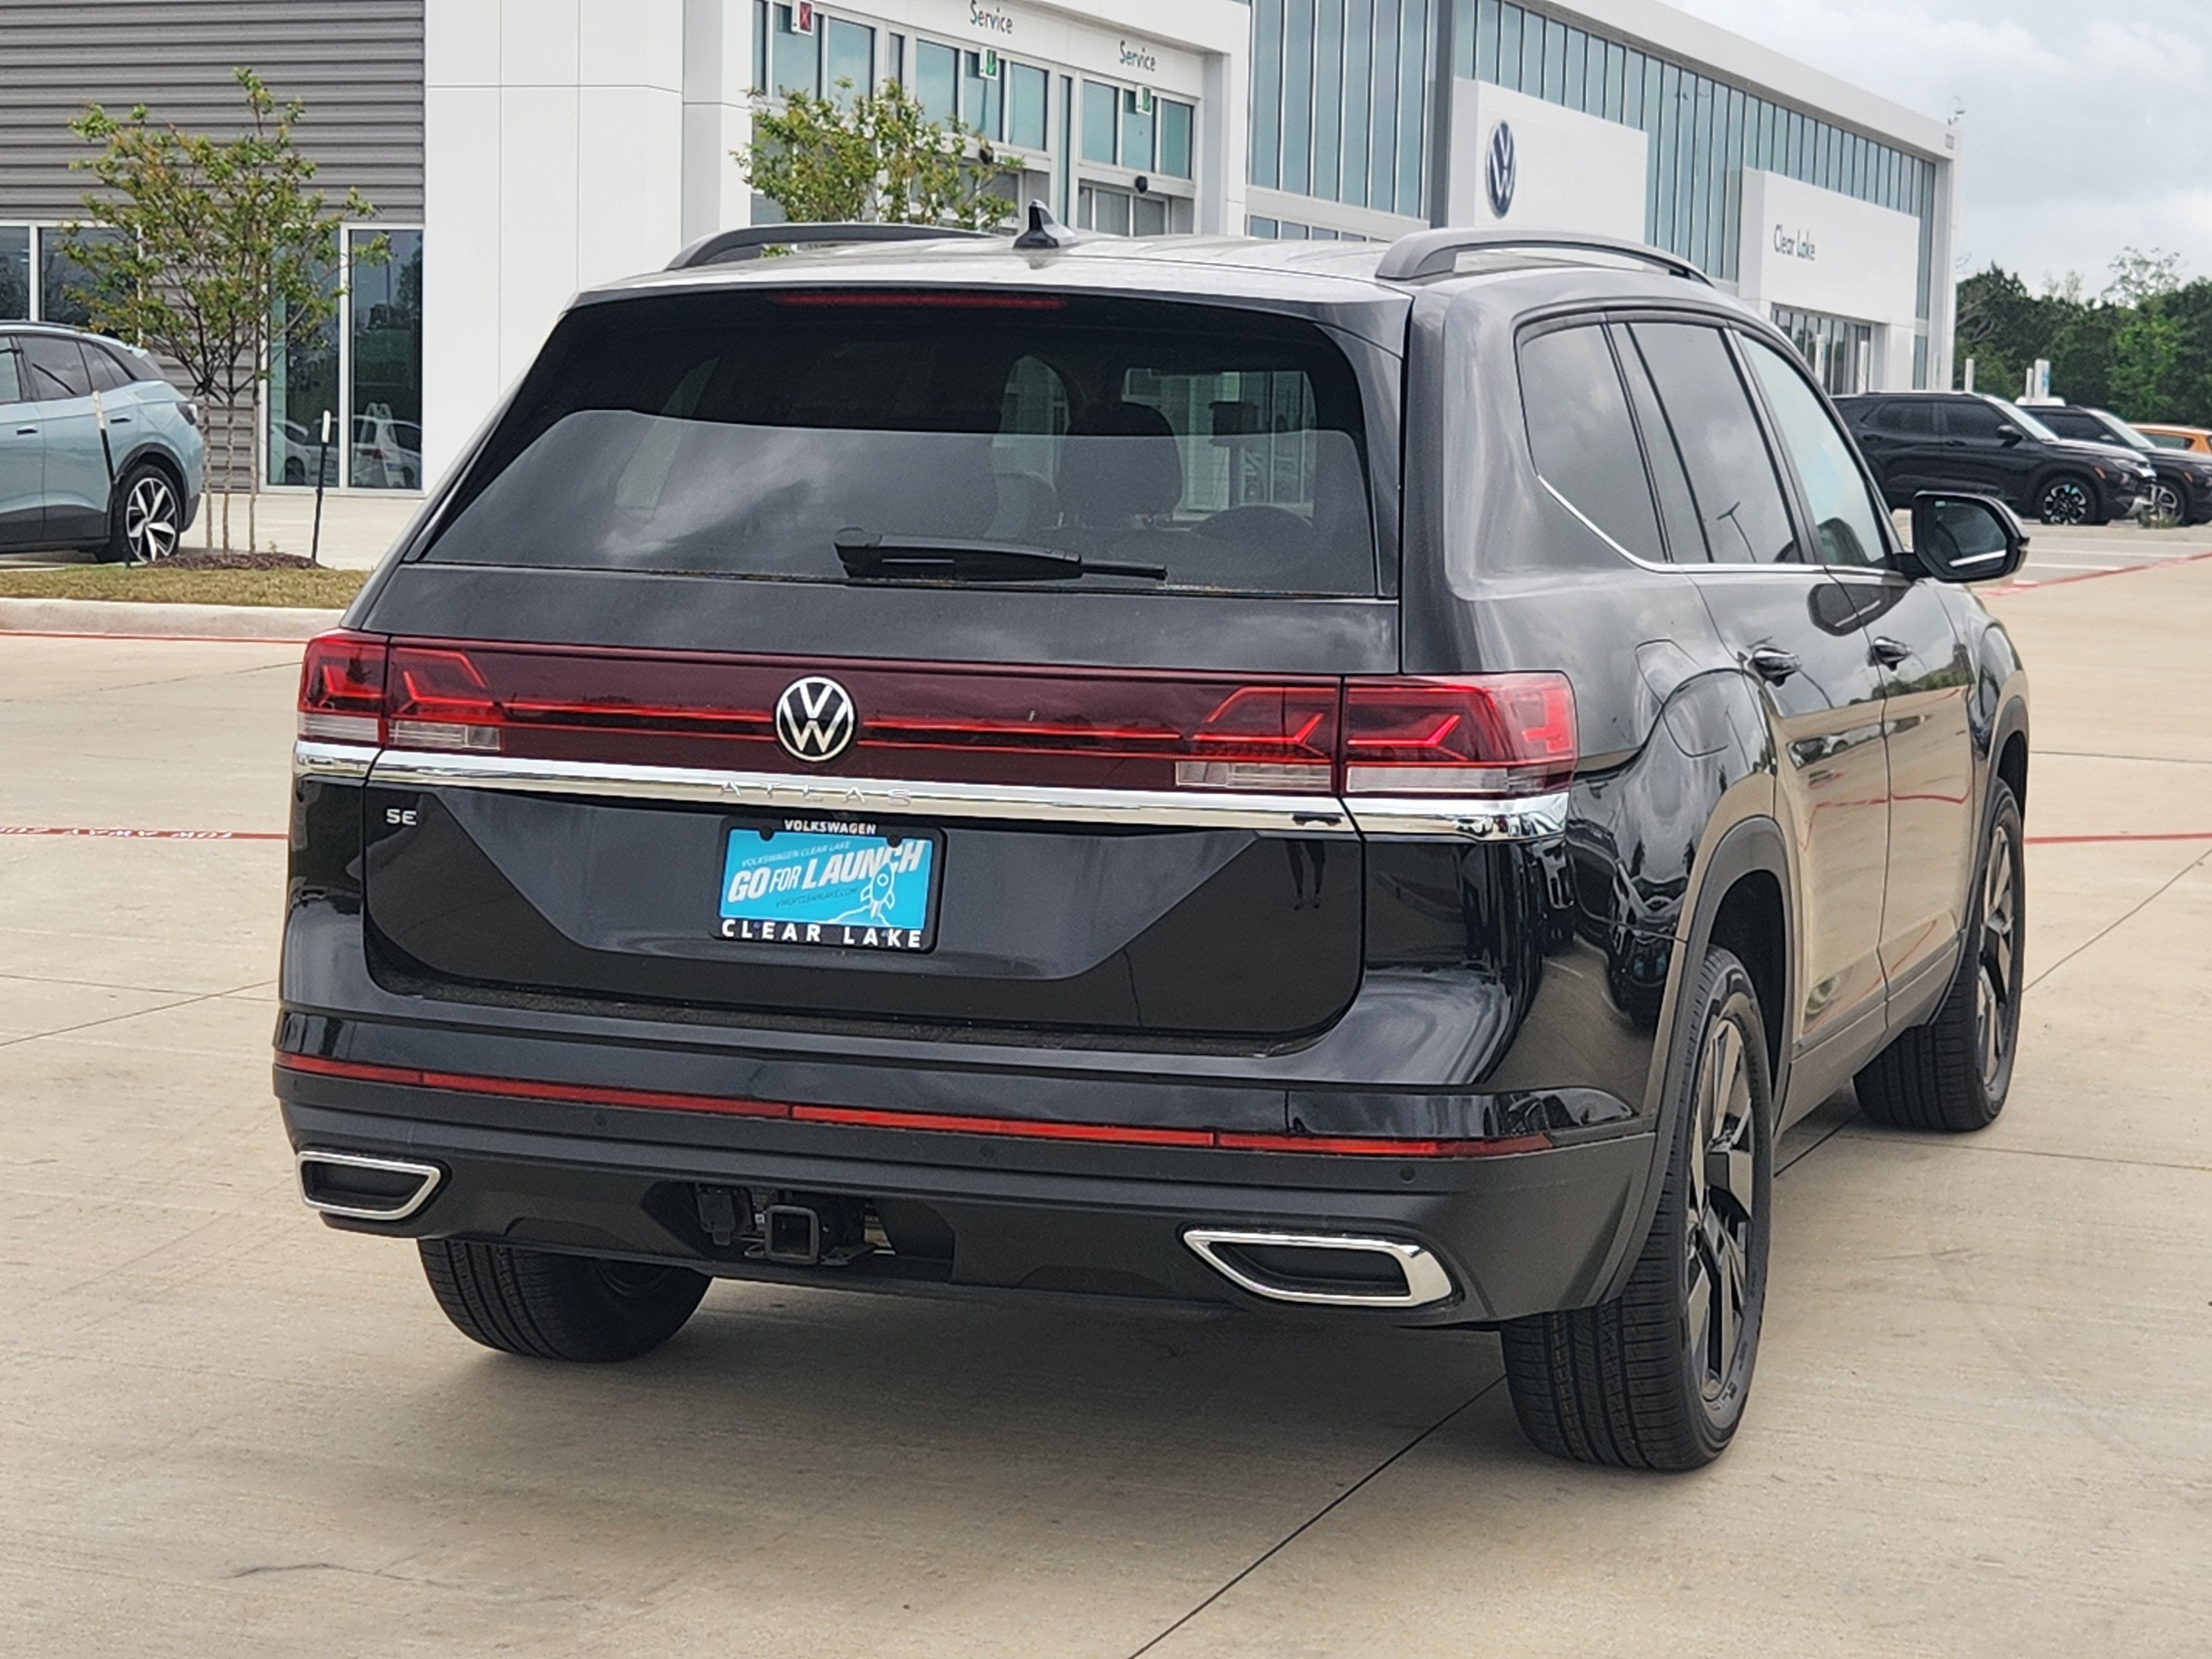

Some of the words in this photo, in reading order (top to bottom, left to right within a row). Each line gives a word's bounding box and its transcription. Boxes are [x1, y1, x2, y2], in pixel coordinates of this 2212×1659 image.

[970, 0, 1013, 34] Service
[1119, 40, 1156, 72] Service
[1773, 224, 1795, 256] Clear
[1797, 229, 1815, 262] Lake
[778, 677, 853, 760] VW
[719, 780, 911, 807] ATLAS
[387, 808, 417, 826] SE
[784, 819, 877, 835] VOLKSWAGEN
[829, 840, 851, 852] LAKE
[727, 867, 771, 903] GO
[769, 865, 802, 894] FOR
[802, 839, 925, 890] LAUNCH
[722, 919, 822, 942] CLEAR
[843, 926, 921, 948] LAKE
